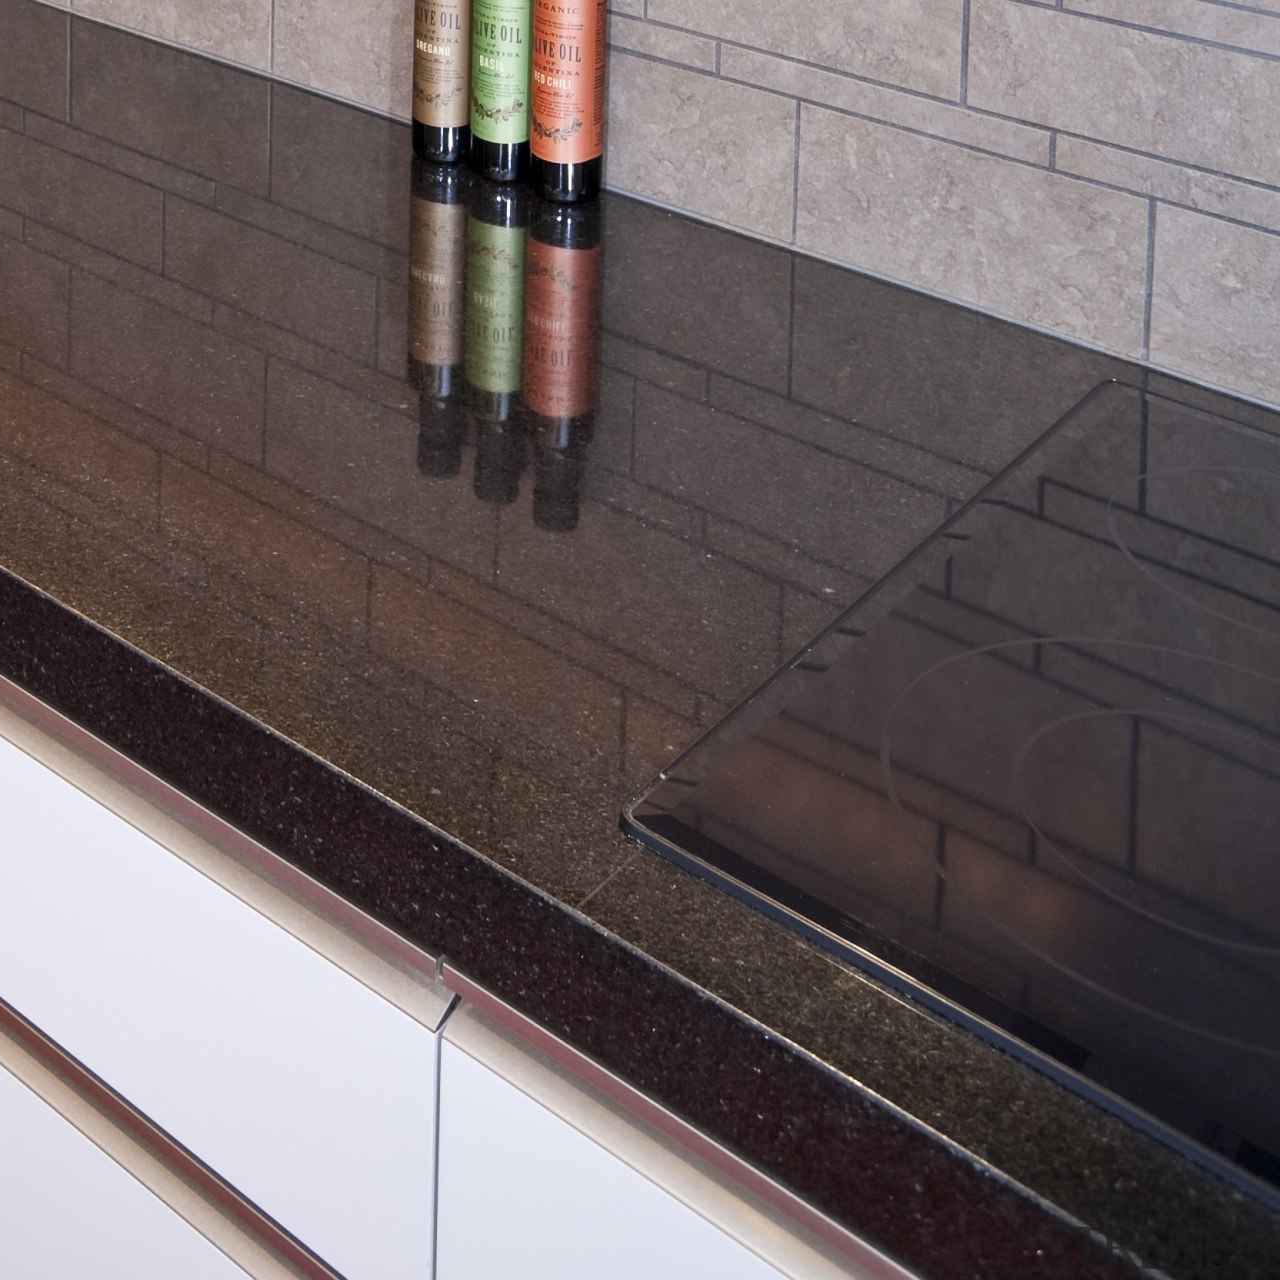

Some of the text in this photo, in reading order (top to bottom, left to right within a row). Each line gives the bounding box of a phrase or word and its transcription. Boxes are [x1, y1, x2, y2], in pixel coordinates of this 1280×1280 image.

[416, 6, 461, 30] LIVE OIL
[475, 18, 522, 44] LIVE OIL
[416, 38, 451, 57] OREGANO
[534, 35, 581, 63] LIVE OIL
[480, 55, 504, 72] BASIL
[534, 69, 571, 89] RED CHILI
